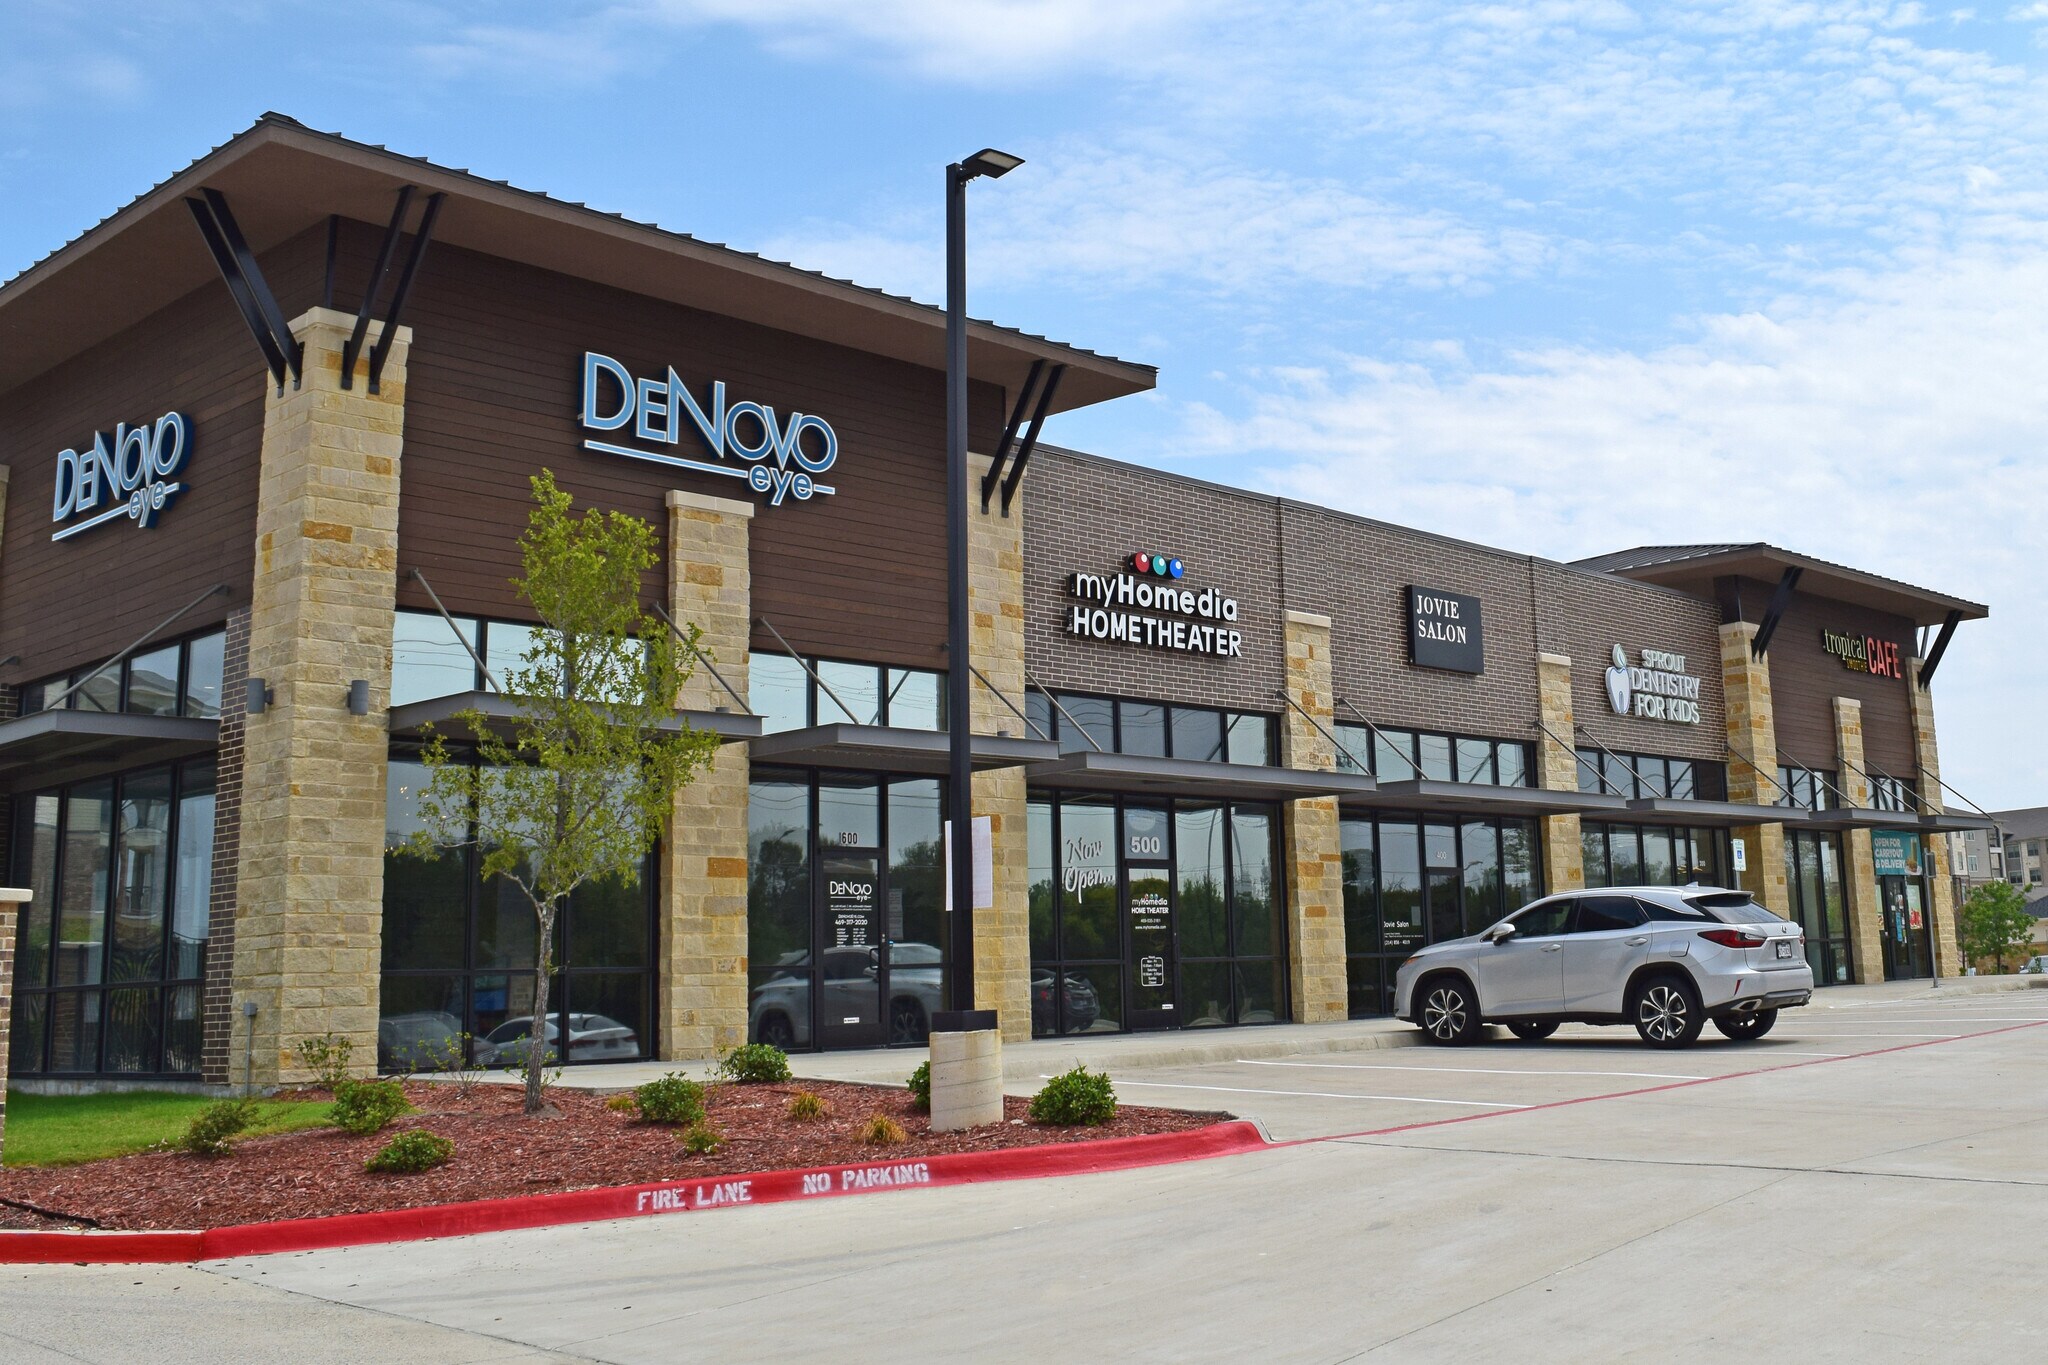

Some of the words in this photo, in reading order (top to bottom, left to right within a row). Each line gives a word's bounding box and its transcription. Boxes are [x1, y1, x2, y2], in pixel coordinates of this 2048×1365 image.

[750, 465, 814, 506] eye
[128, 481, 166, 528] eye
[1076, 573, 1238, 622] myHomedia
[1417, 595, 1460, 620] JOVIE
[1418, 620, 1467, 645] SALON
[1641, 649, 1686, 673] SPROUT
[1824, 629, 1867, 660] tropical
[1867, 637, 1901, 679] CAFE
[1631, 667, 1700, 699] DENTISTRY
[1634, 693, 1667, 719] FOR
[1667, 698, 1701, 724] KIDS
[1066, 837, 1103, 864] Now
[1131, 836, 1160, 854] 500
[1874, 837, 1890, 847] OPEN
[1890, 838, 1901, 848] FOR
[1874, 848, 1904, 858] CARRYOUT
[1875, 859, 1881, 868] &
[1881, 859, 1906, 869] DELIVERY
[1131, 906, 1146, 914] HOME
[1146, 906, 1169, 914] THEATER
[1396, 920, 1410, 928] Salon
[638, 1187, 685, 1211] FIRE
[696, 1181, 753, 1206] LANE
[803, 1172, 831, 1194] NO
[842, 1163, 930, 1190] PARKING
